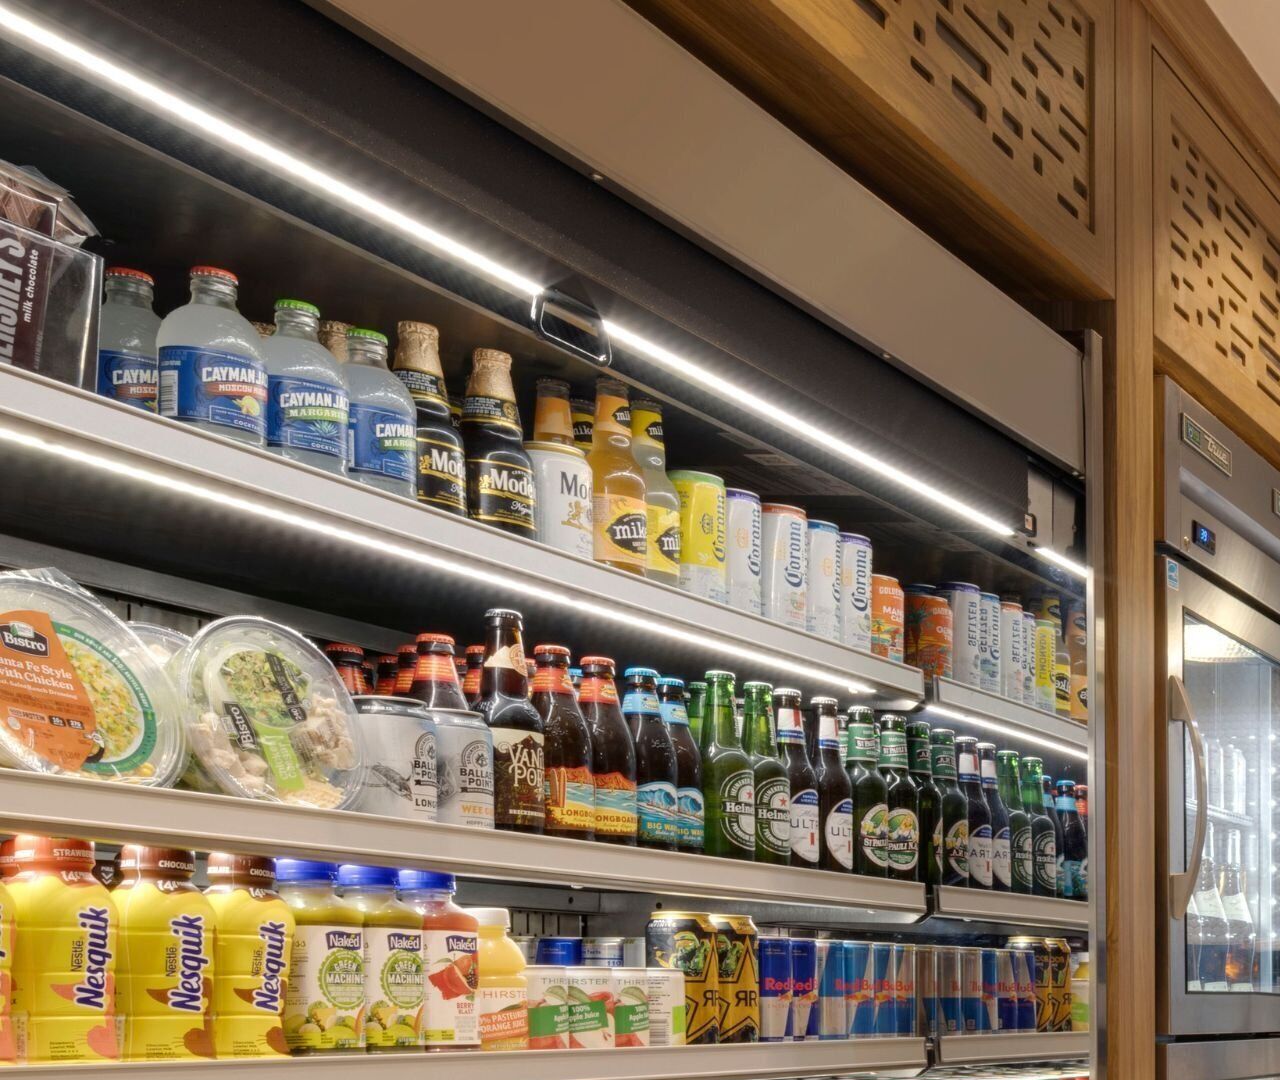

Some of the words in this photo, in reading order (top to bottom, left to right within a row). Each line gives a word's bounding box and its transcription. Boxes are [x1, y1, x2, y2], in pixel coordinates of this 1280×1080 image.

[23, 300, 33, 323] milk
[28, 249, 39, 299] chocolate
[201, 366, 255, 384] CAYMAN
[218, 384, 253, 394] MOSCOW
[279, 393, 332, 408] CAYMAN
[375, 423, 414, 439] CAYMAN
[747, 508, 762, 577] Corona
[784, 521, 803, 589] Corona
[851, 549, 869, 613] Corona
[3, 631, 46, 653] Bistro
[25, 660, 41, 672] Fe
[41, 664, 73, 680] Style
[24, 671, 75, 691] Chicken
[231, 706, 254, 750] Bistro
[647, 821, 663, 830] BIG
[329, 933, 361, 950] Naked
[390, 935, 421, 950] Naked
[449, 937, 477, 951] Naked
[74, 905, 113, 1010] Nesquik
[167, 913, 209, 1013] Nesquik
[253, 920, 287, 1013] Nesquik
[333, 961, 358, 973] GREEN
[394, 961, 418, 973] GREEN
[326, 972, 365, 985] MACHINE
[387, 972, 424, 985] MACHINE
[764, 977, 791, 991] Red
[456, 1002, 475, 1010] BERRY
